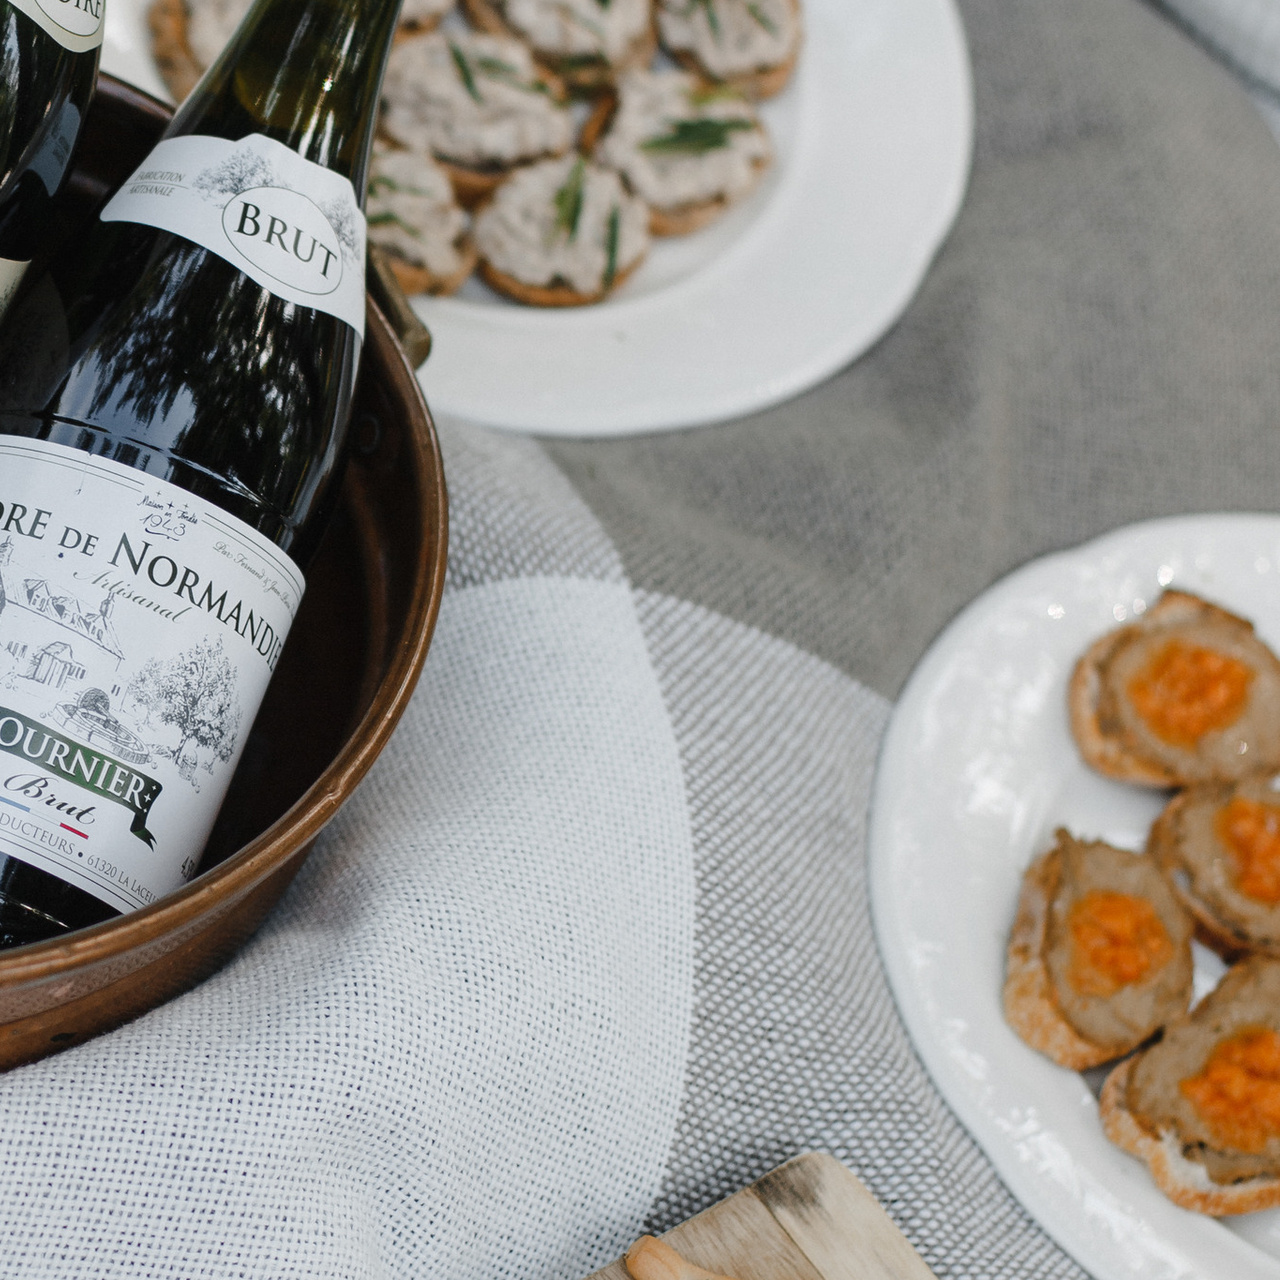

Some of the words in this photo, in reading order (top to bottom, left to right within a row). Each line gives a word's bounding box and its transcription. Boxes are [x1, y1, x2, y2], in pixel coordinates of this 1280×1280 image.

[234, 200, 338, 280] BRUT
[58, 525, 100, 557] DE
[139, 513, 186, 536] 1943
[73, 569, 193, 624] Artisanal
[3, 773, 96, 825] Brut
[87, 855, 118, 878] 61320
[118, 871, 130, 887] LA
[130, 880, 159, 904] LACELL
